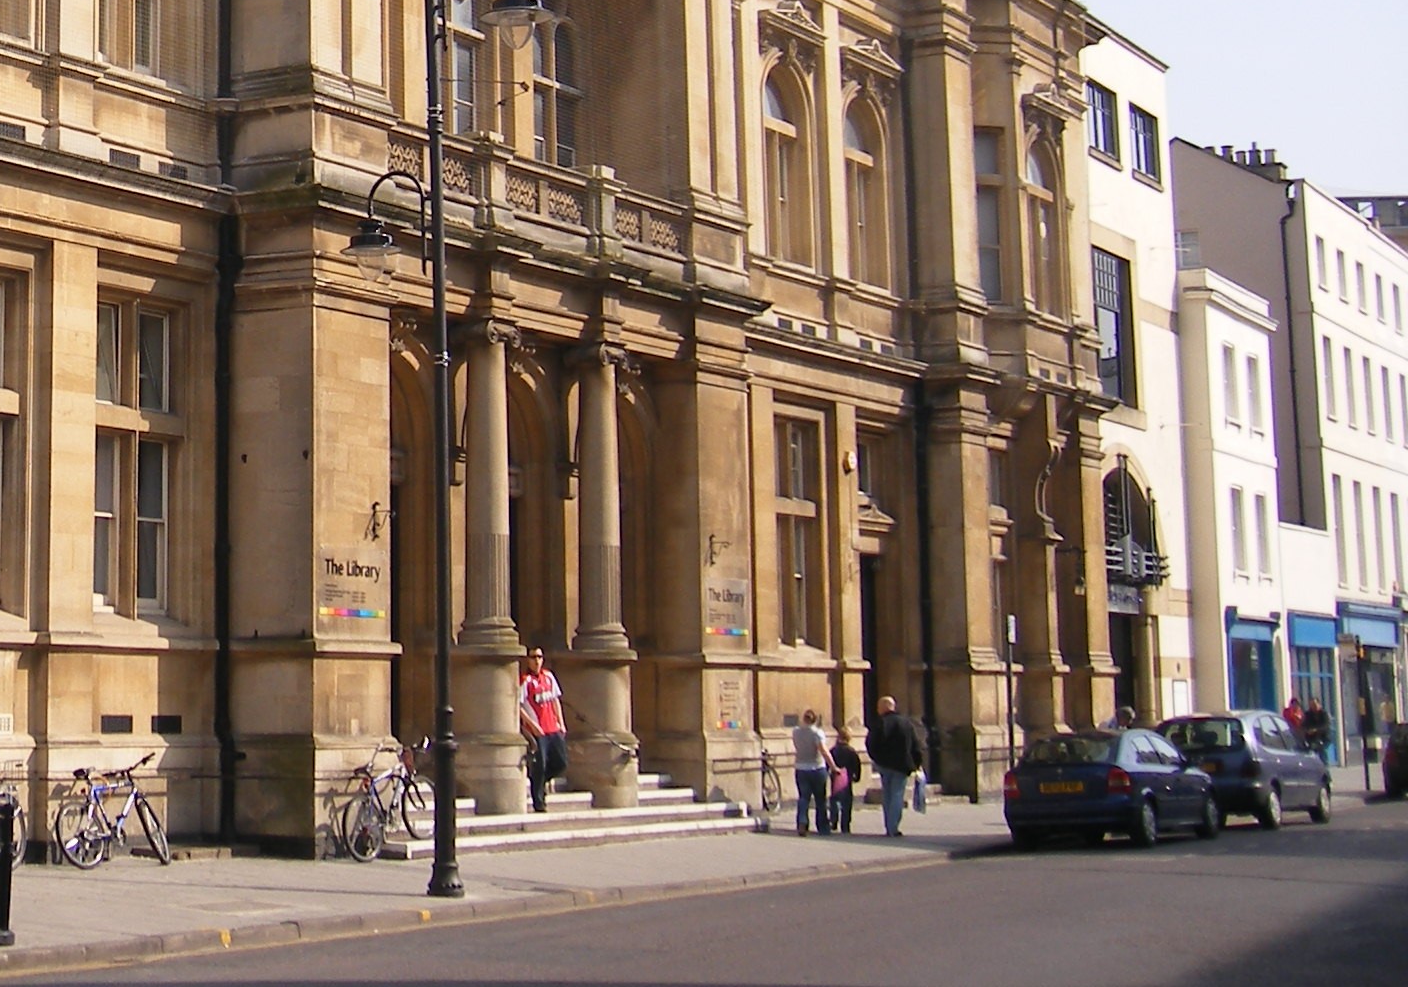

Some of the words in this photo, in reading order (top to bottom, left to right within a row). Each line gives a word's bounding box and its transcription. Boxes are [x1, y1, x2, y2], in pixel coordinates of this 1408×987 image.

[325, 558, 344, 576] The
[346, 560, 381, 584] Library
[708, 587, 721, 602] The
[722, 588, 745, 608] Library
